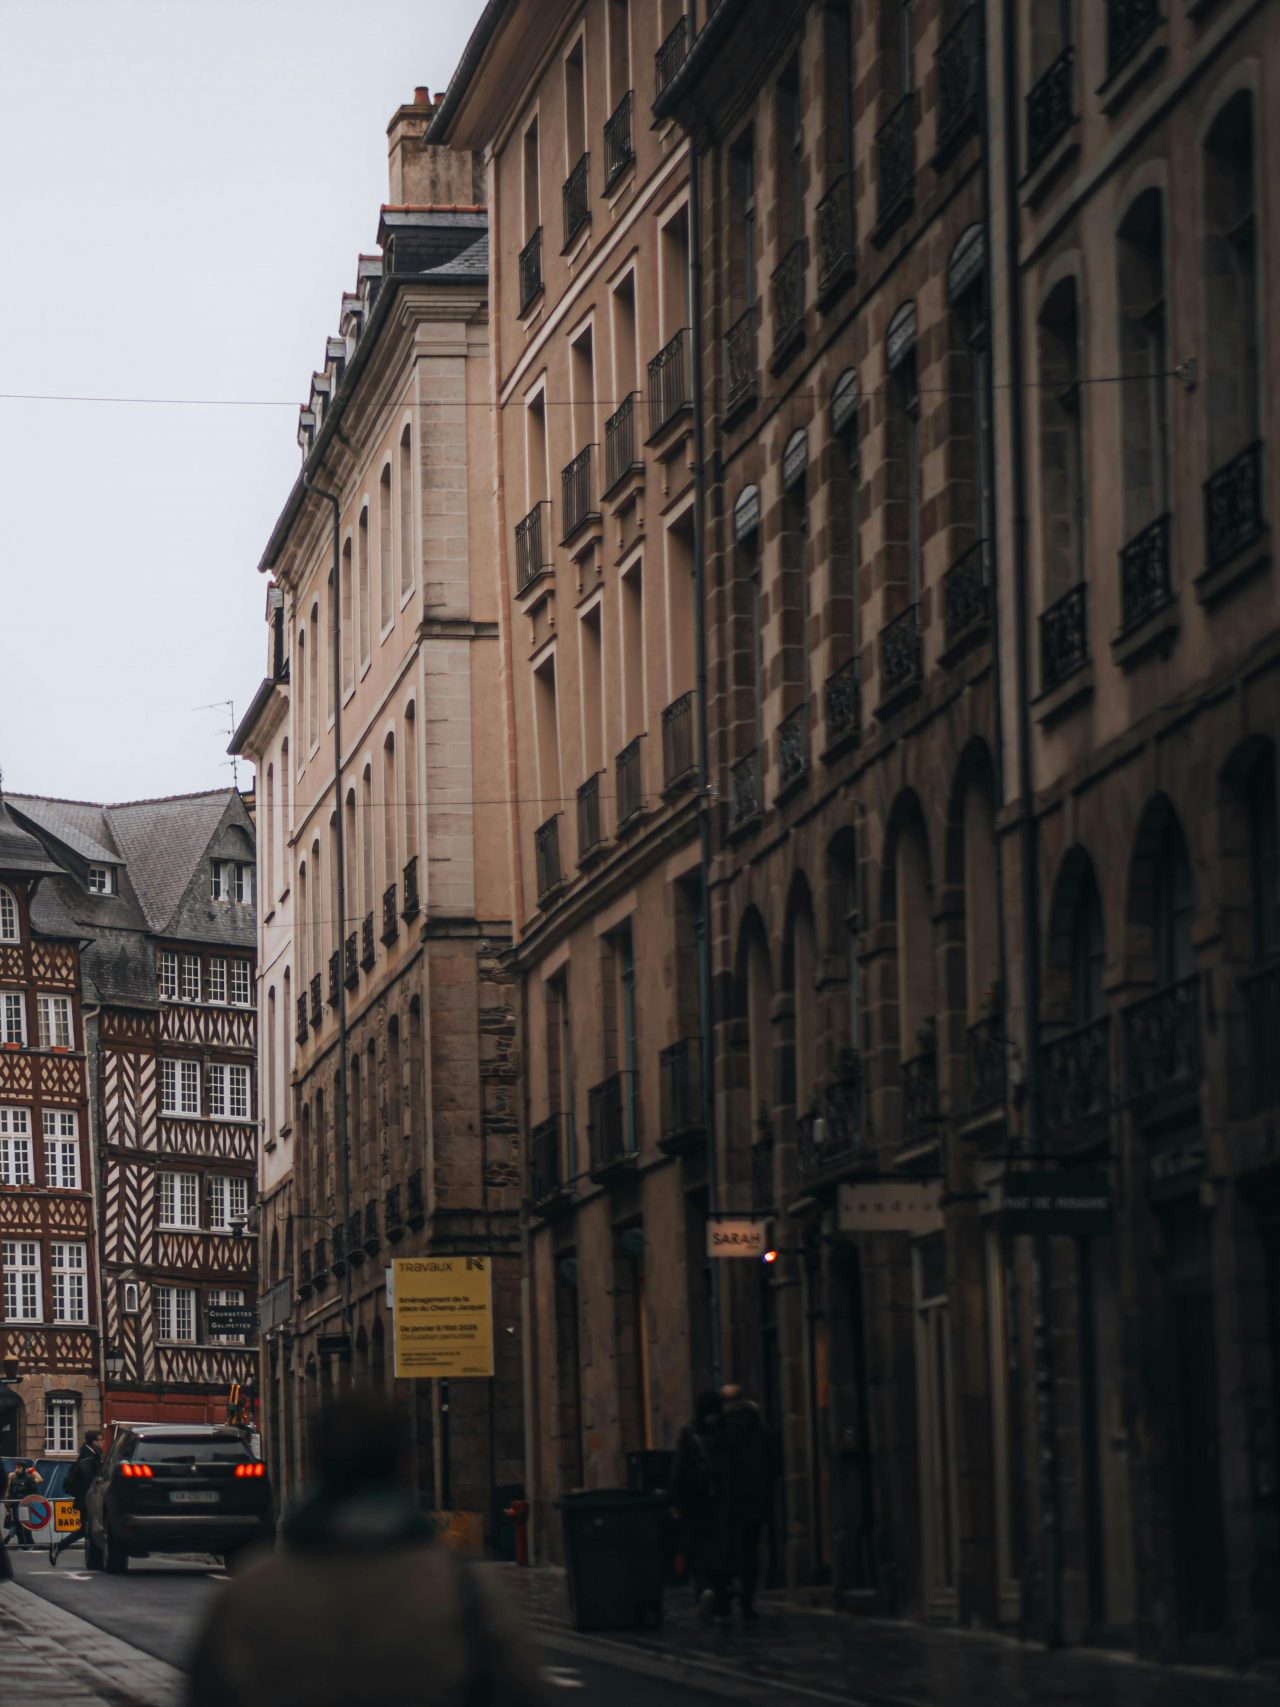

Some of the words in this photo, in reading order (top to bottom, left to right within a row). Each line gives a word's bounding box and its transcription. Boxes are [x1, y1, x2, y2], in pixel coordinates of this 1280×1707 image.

[712, 1231, 761, 1246] SARAH
[61, 1506, 79, 1516] ROU
[58, 1518, 82, 1527] BARR
